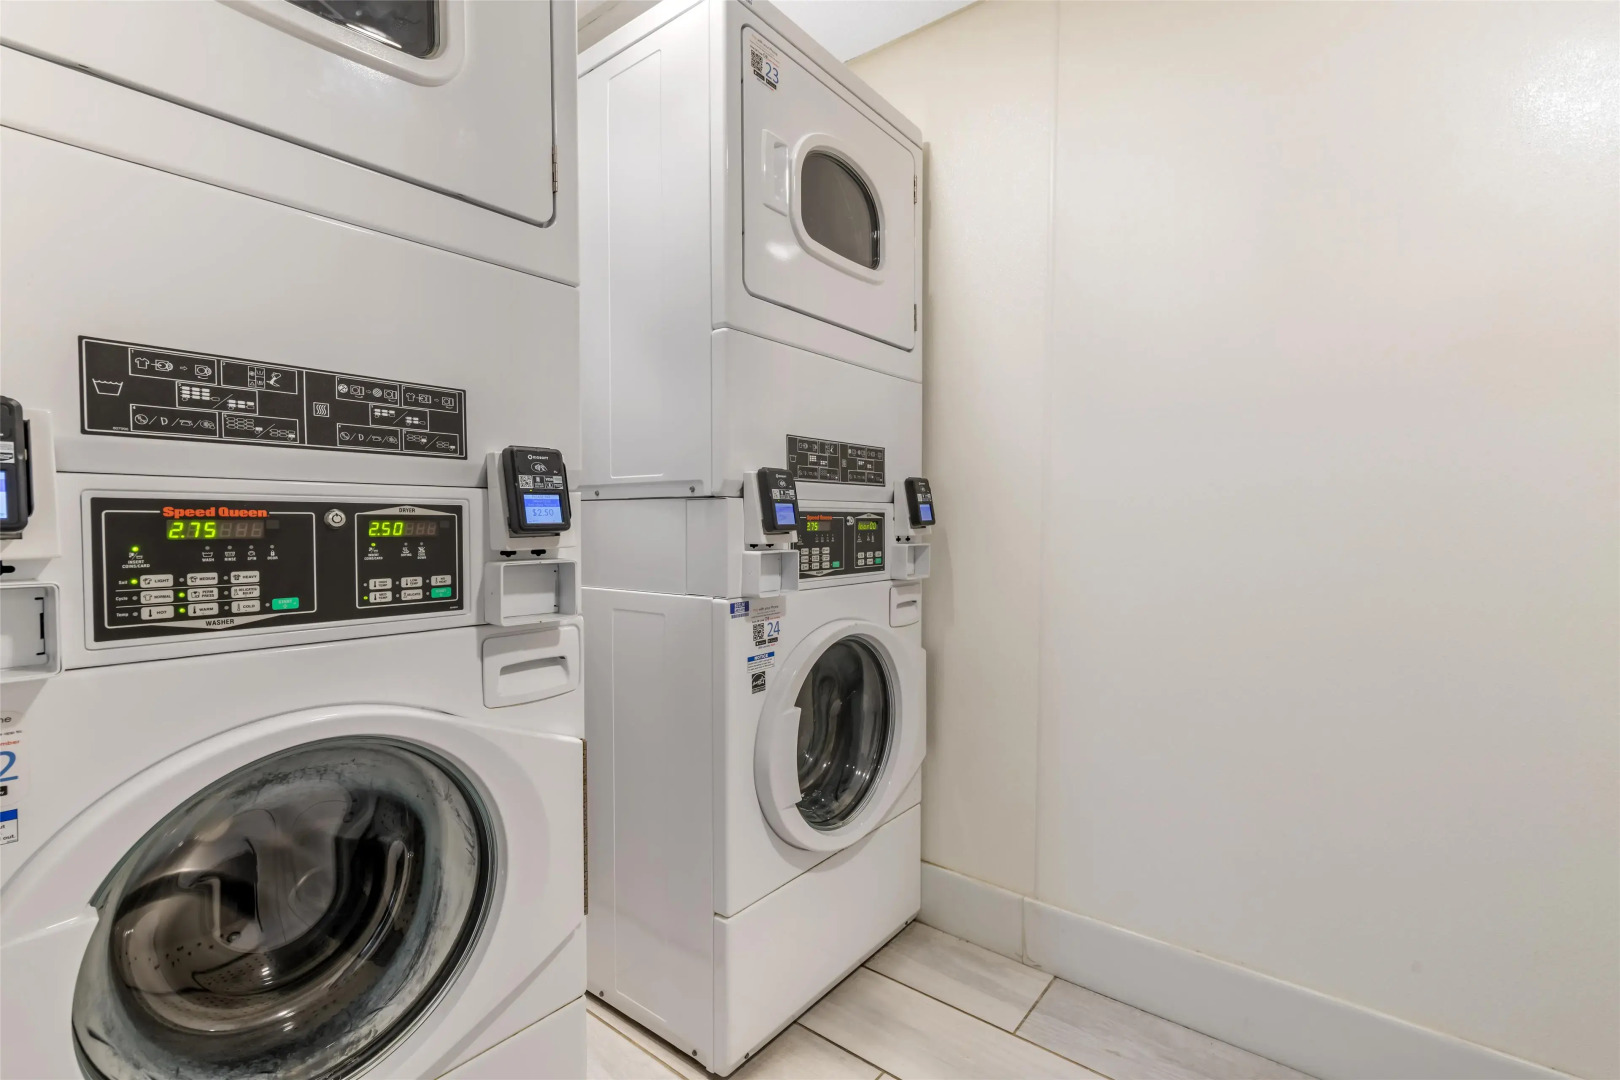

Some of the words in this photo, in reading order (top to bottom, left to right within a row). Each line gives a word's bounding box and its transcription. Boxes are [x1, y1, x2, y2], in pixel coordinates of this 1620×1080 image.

[766, 62, 778, 84] 23
[162, 506, 216, 518] Speed
[218, 507, 268, 517] Queen
[168, 522, 216, 538] 2.75
[369, 522, 403, 536] 2.50
[767, 620, 780, 637] 24
